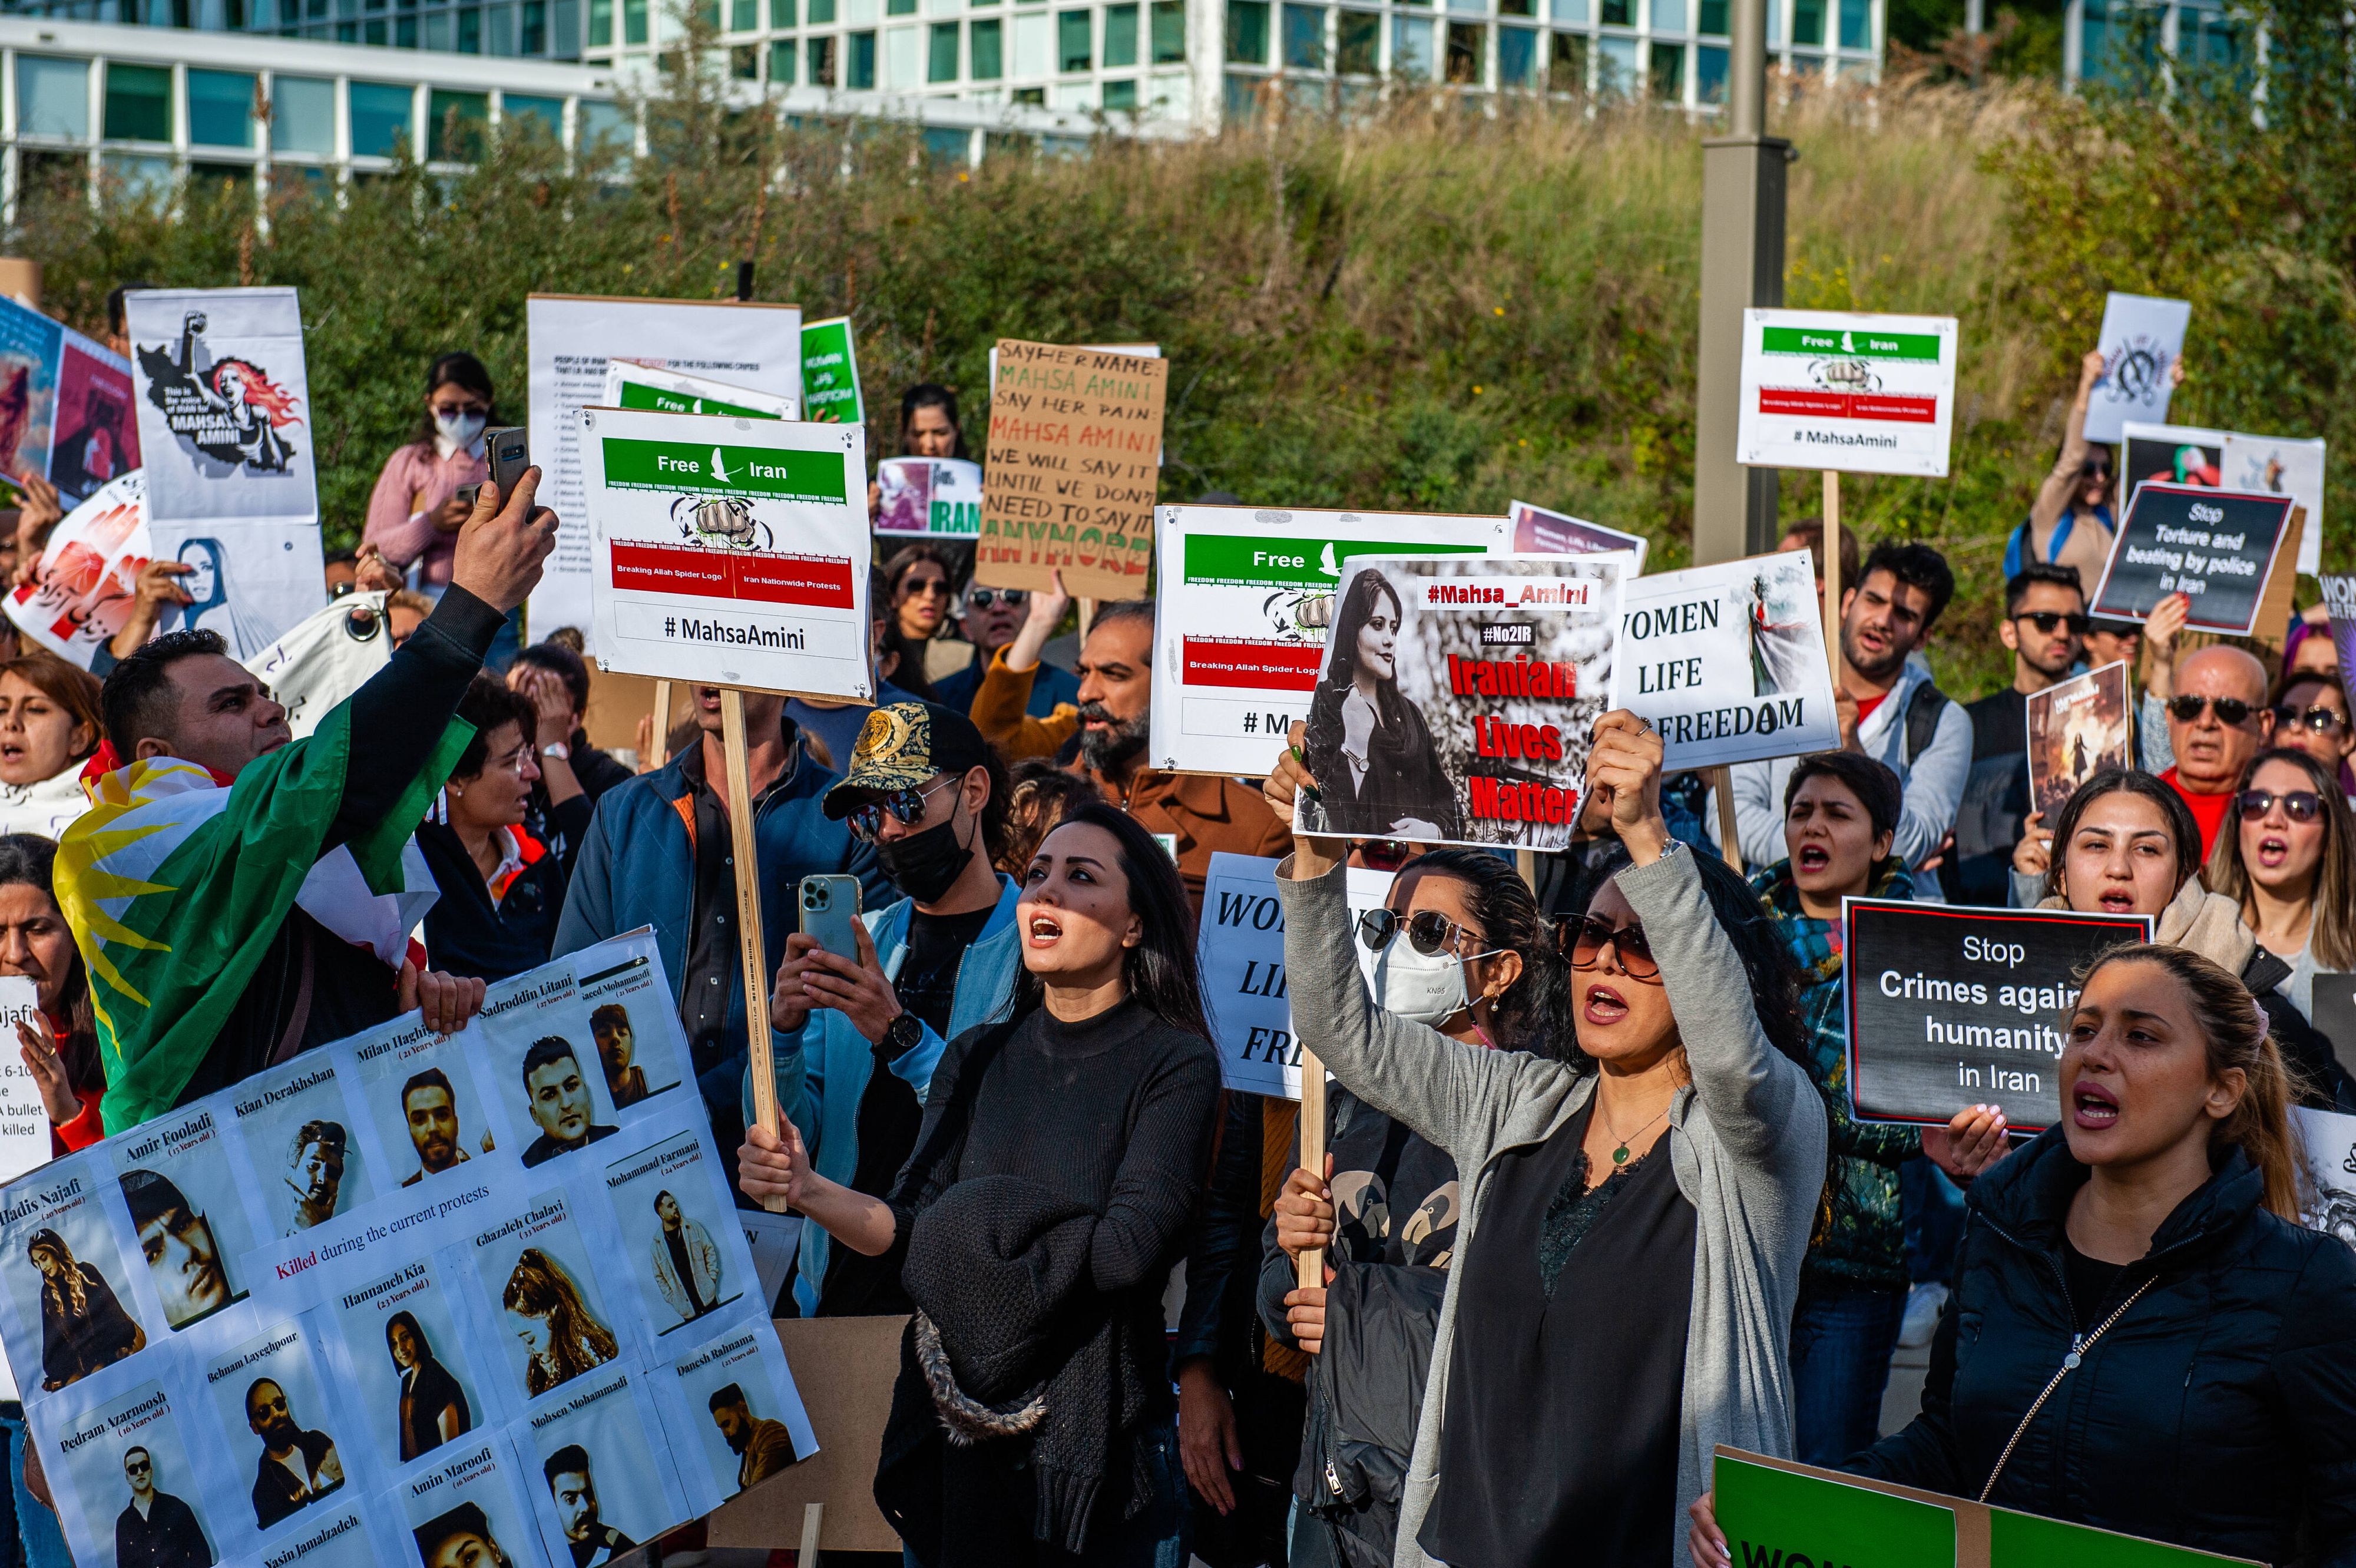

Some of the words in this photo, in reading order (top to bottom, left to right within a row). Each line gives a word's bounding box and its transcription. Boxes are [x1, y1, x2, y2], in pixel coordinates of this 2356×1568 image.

[1802, 335, 1834, 348] Free
[1870, 339, 1898, 351] Iran
[999, 365, 1076, 393] MAHSA
[1084, 375, 1150, 401] AMINI
[657, 397, 685, 412] Free
[995, 391, 1033, 410] SAY
[1041, 397, 1088, 415] HER
[171, 414, 226, 431] MAHSA
[990, 415, 1070, 446] MAHSA
[1078, 425, 1156, 454] AMINI
[197, 428, 240, 444] AMINI
[1807, 431, 1897, 448] MahsaAmini
[658, 455, 699, 473] Free
[750, 462, 787, 479] Iran
[990, 448, 1020, 464] WE
[1028, 452, 1070, 472] WILL
[1081, 458, 1121, 478] SAY
[1129, 465, 1152, 478] IT
[987, 472, 1047, 493] UNTIL
[1056, 479, 1085, 498] WE
[931, 501, 981, 533] IRAN
[986, 495, 1052, 518] NEED
[1059, 504, 1090, 522] TO
[1095, 507, 1132, 535] SAY
[1134, 514, 1153, 532] IT
[2189, 502, 2223, 526] Stop
[978, 519, 1150, 575] ANYMORE
[2156, 524, 2211, 547] Torture
[2212, 532, 2245, 551] and
[1253, 551, 1305, 568] Free
[2126, 545, 2183, 571] beating
[2185, 551, 2207, 574] by
[2206, 556, 2256, 575] police
[617, 565, 652, 575] Breaking
[654, 568, 673, 576] Allah
[675, 570, 700, 580] Spider
[701, 572, 722, 581] Logo
[762, 577, 805, 588] Nationwide
[807, 581, 841, 590] Protests
[2159, 571, 2175, 590] in
[2177, 574, 2206, 594] Iran
[682, 618, 804, 650] MahsaAmini
[1483, 626, 1531, 642] #No2IR
[1190, 661, 1233, 671] Breaking
[1236, 663, 1259, 671] Allah
[1262, 665, 1294, 674] Spider
[1447, 653, 1577, 698] Iranian
[1639, 657, 1702, 694] LIFE
[1474, 715, 1562, 760] Lives
[1468, 776, 1578, 825] Matter
[1963, 936, 2024, 969] Stop
[603, 968, 650, 993] Mohammadi
[624, 984, 640, 994] Years
[1427, 987, 1446, 995] KN95
[1880, 971, 1988, 1004] Crimes
[479, 990, 538, 1020] Sadroddin
[539, 973, 573, 997] Litani
[547, 994, 562, 1005] Years
[0, 1004, 33, 1028] jafi
[411, 1042, 432, 1054] Years
[1926, 1015, 2071, 1060] humanity
[357, 1042, 391, 1063] Milan
[1958, 1061, 1980, 1088] in
[1991, 1065, 2040, 1093] Iran
[234, 1096, 263, 1118] Kian
[264, 1066, 335, 1105] Derakhshan
[8, 1103, 42, 1116] bullet
[2, 1123, 35, 1136] killed
[127, 1137, 160, 1163] Amir
[161, 1112, 212, 1146] Fooladi
[179, 1139, 198, 1150] Years
[605, 1156, 659, 1190] Mohammad
[660, 1139, 700, 1165] Farmani
[672, 1159, 689, 1172] Years
[0, 1199, 39, 1226] Hadis
[39, 1178, 82, 1208] Najafi
[54, 1203, 71, 1215] Years
[275, 1251, 317, 1281] Killed
[320, 1238, 365, 1261] during
[366, 1224, 388, 1243] the
[390, 1206, 436, 1233] current
[438, 1185, 489, 1218] protests
[476, 1217, 524, 1248] Ghazaleh
[524, 1199, 564, 1225] Chalavi
[531, 1220, 551, 1235] Years
[342, 1271, 403, 1310] Hannaneh
[404, 1262, 425, 1283] Kia
[390, 1286, 412, 1304] Years
[207, 1359, 244, 1384] Behnam
[243, 1332, 298, 1365] Layeghpour
[676, 1354, 710, 1377] Danesh
[710, 1332, 755, 1362] Rahnama
[530, 1407, 568, 1431] Mohsen
[567, 1375, 628, 1409] Mohammadi
[59, 1425, 105, 1454] Pedram
[107, 1391, 167, 1431] Azarnoosh
[130, 1414, 151, 1433] Years
[412, 1475, 444, 1498] Amin
[444, 1447, 492, 1481] Maroofi
[462, 1471, 481, 1486] Years
[294, 1514, 359, 1554] Jamalzadeh
